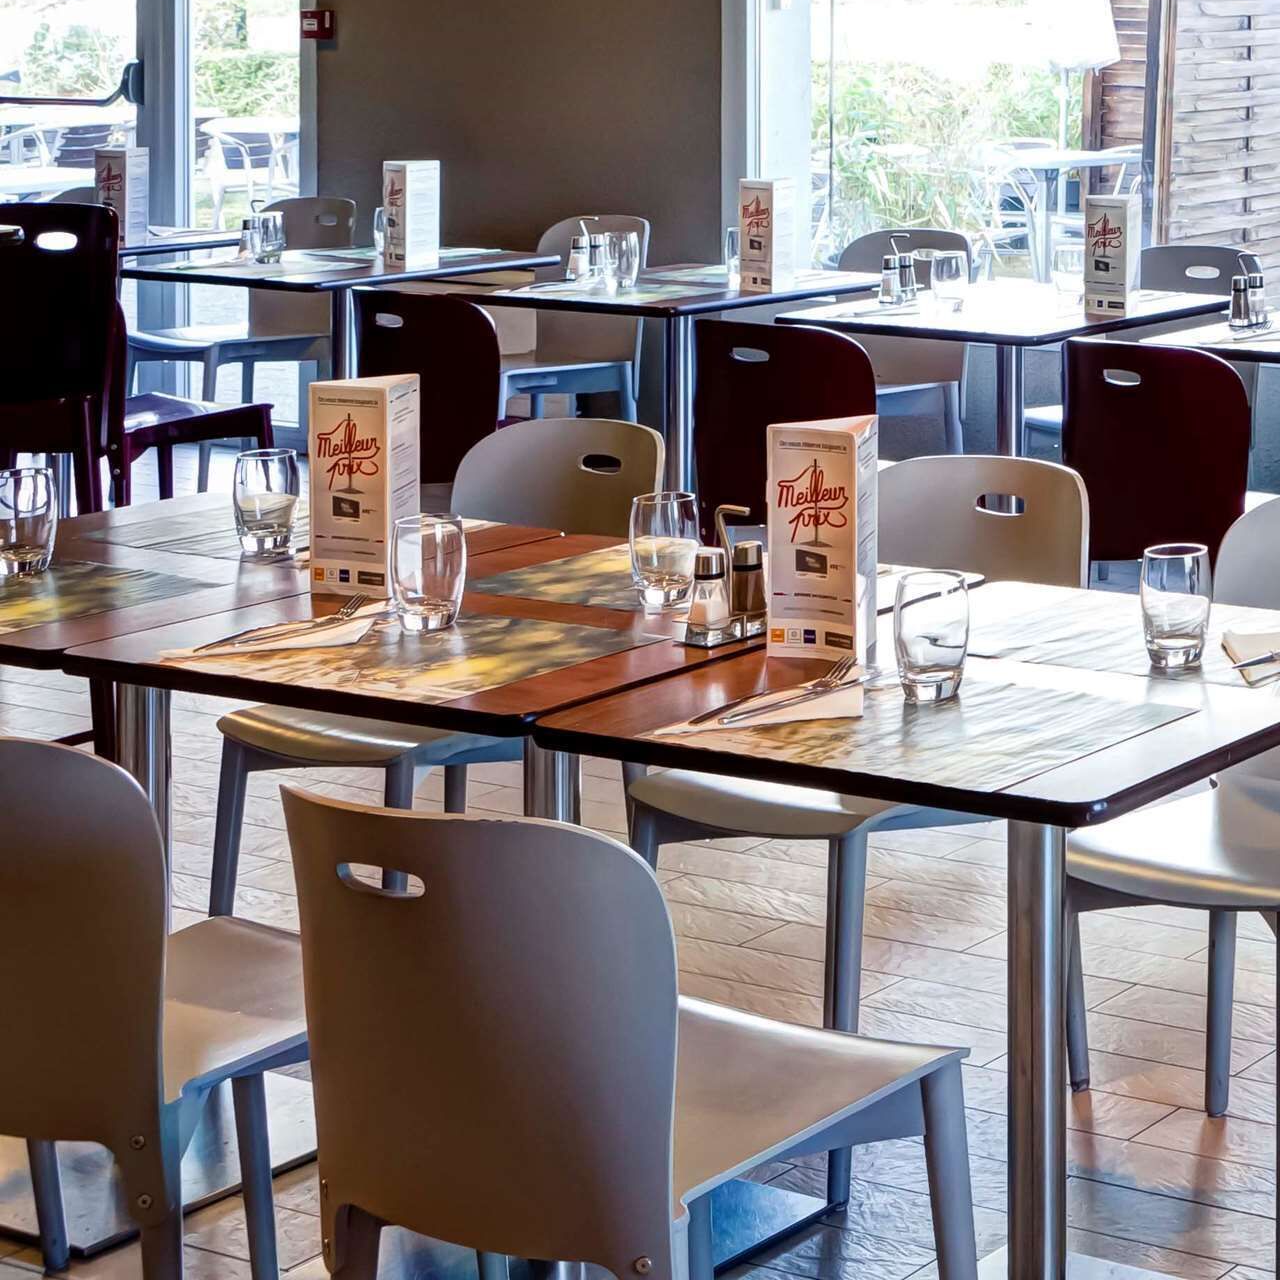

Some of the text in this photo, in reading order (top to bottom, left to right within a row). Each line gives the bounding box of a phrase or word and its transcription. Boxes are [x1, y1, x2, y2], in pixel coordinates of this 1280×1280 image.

[317, 421, 380, 458] Meilleur
[327, 458, 379, 490] prix
[778, 470, 848, 508] Meilleur
[788, 507, 847, 543] prix
